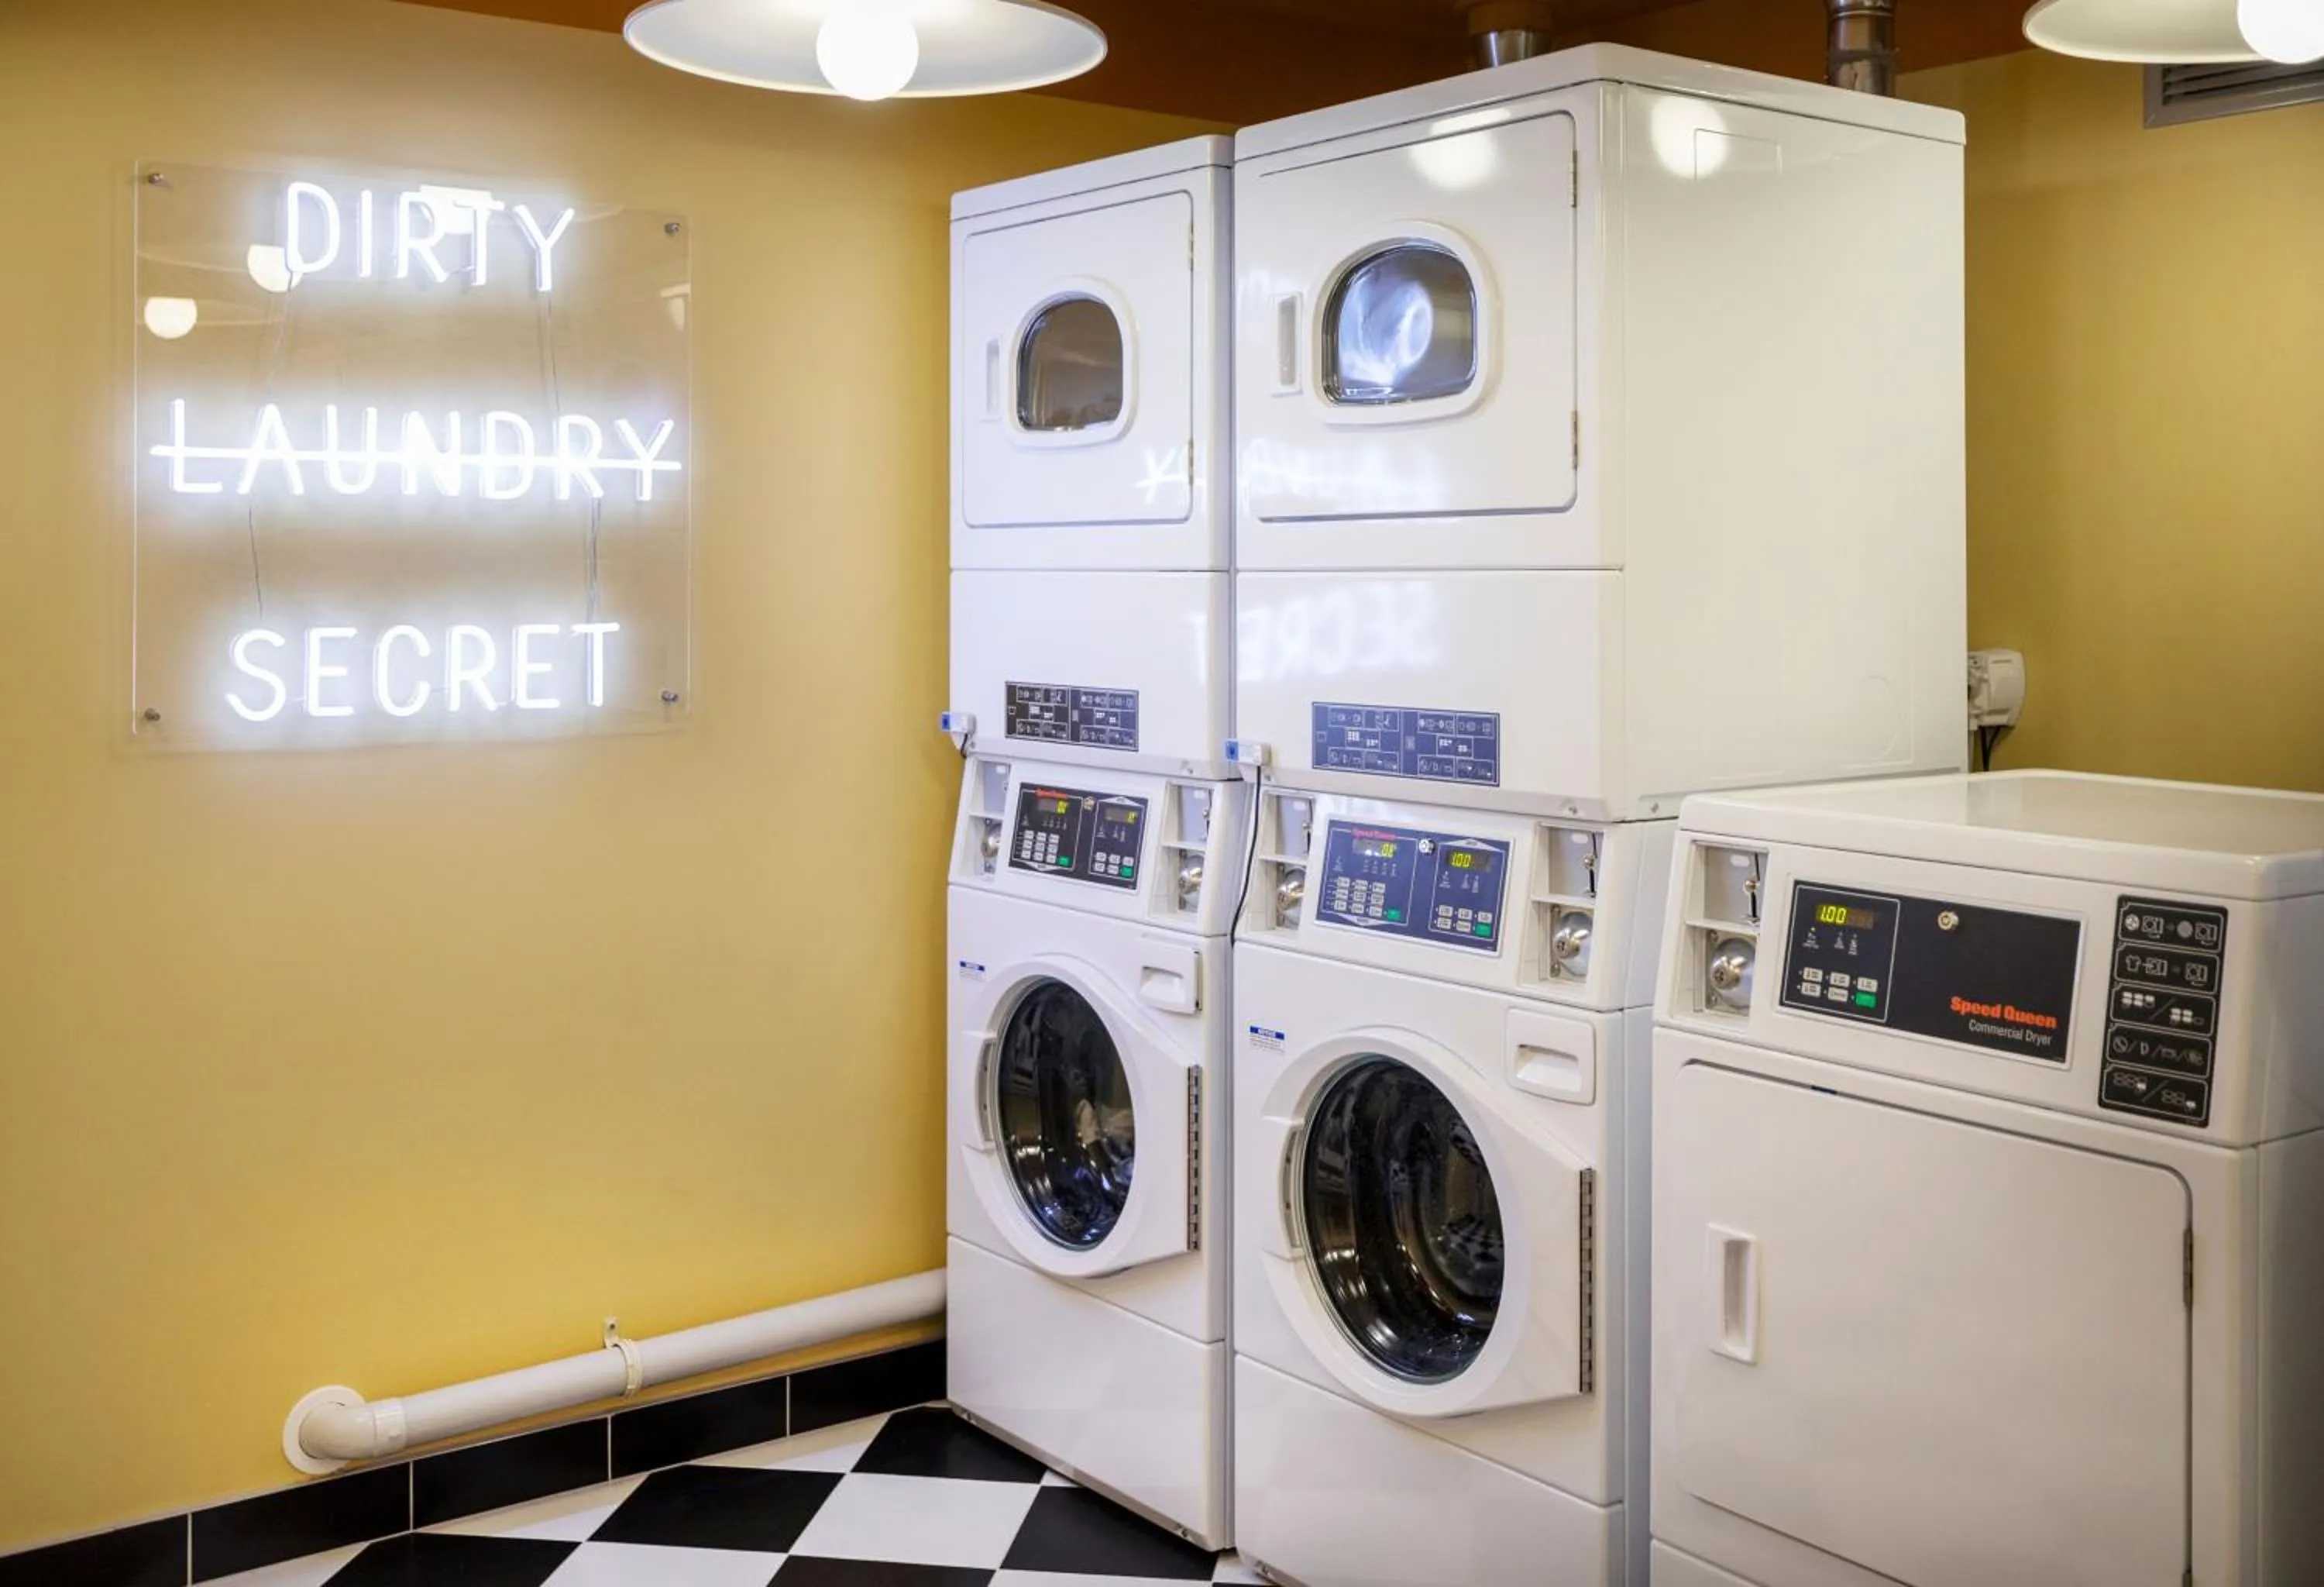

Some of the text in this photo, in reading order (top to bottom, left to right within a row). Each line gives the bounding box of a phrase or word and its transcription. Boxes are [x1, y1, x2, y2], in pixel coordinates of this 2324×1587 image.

[285, 181, 576, 292] DIRTY
[169, 398, 676, 502] LAUNDRY
[225, 621, 621, 722] SECRET
[1950, 995, 2058, 1029] Speed Queen
[1968, 1018, 2053, 1047] Commercial Dryer
